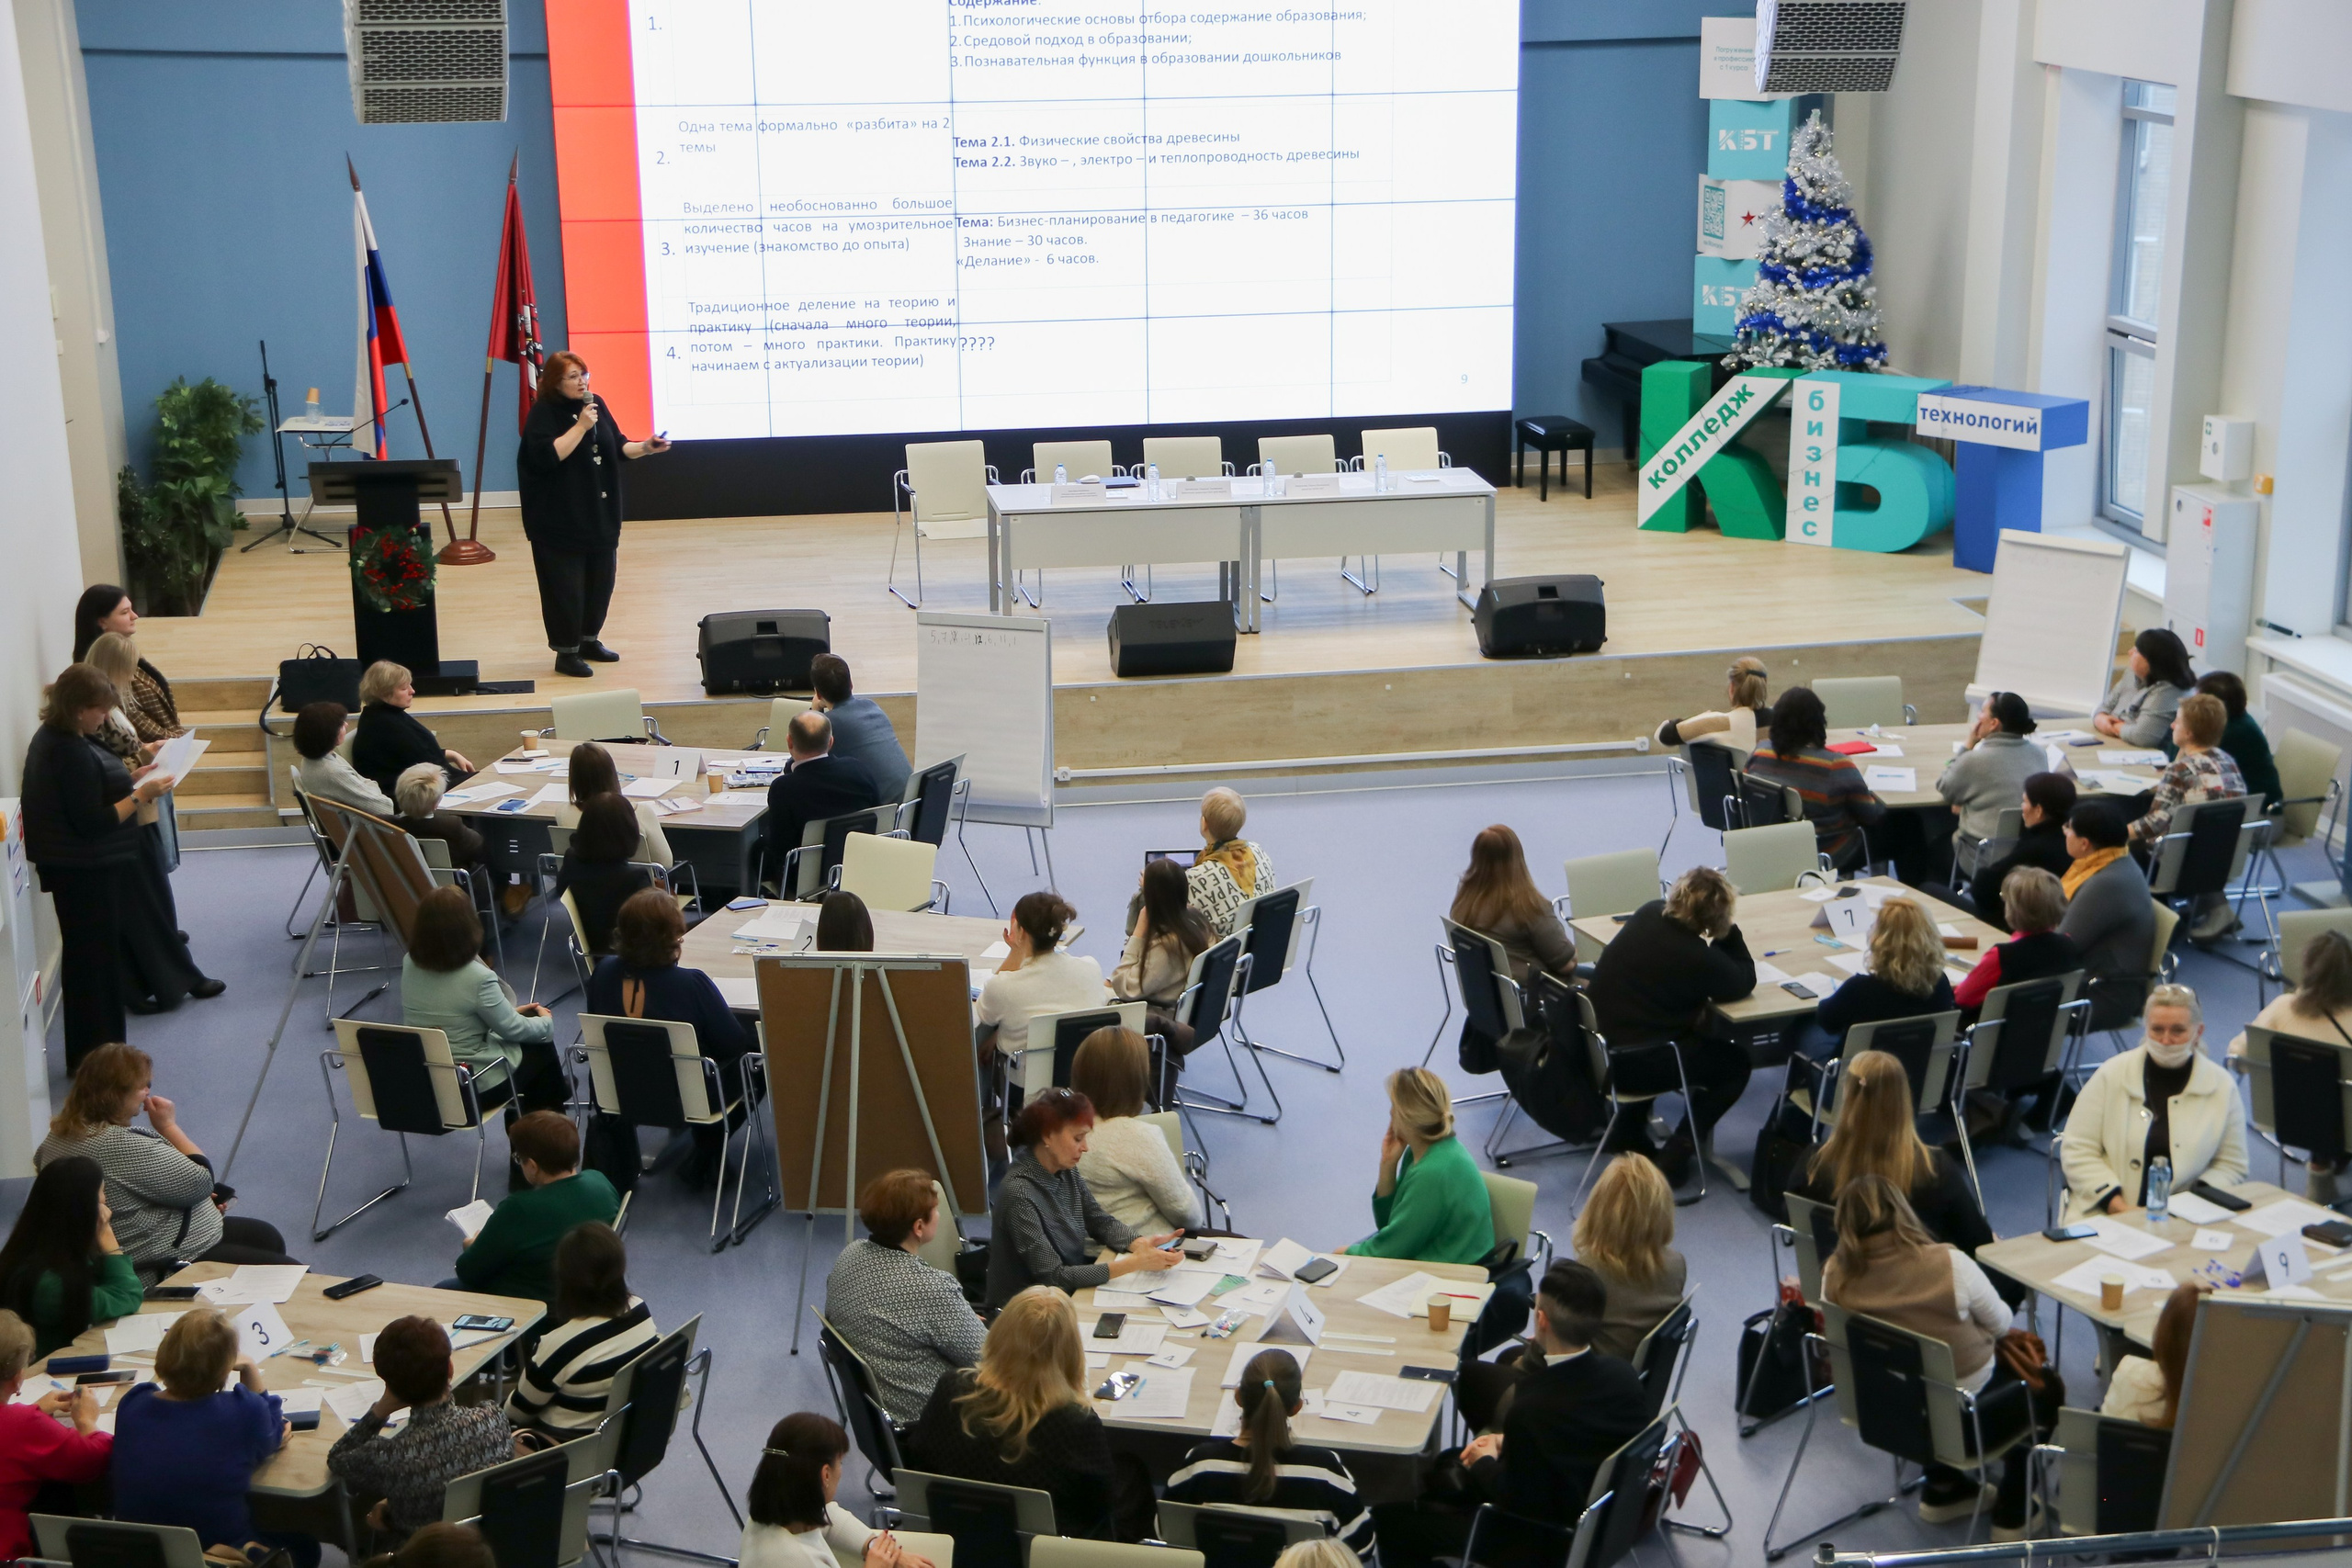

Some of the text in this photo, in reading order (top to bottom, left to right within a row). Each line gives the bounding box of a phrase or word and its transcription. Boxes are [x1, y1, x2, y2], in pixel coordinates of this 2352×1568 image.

[648, 17, 662, 31] 1.
[964, 15, 1080, 26] Психологические
[1085, 15, 1135, 25] основы
[1139, 12, 1186, 26] отбора
[1191, 12, 1272, 25] содержание
[1276, 9, 1367, 23] образования;
[964, 34, 1030, 49] Средовой
[1035, 35, 1083, 47] подход
[1088, 36, 1094, 44] в
[1099, 32, 1192, 46] образовании;
[965, 55, 1074, 67] Познавательная
[1079, 53, 1136, 67] функция
[1140, 55, 1148, 64] в
[1151, 51, 1239, 66] образовании
[1243, 51, 1341, 64] дошкольников
[678, 118, 950, 134] Одна тема формально «разбита» на 2
[680, 142, 716, 153] темы
[954, 132, 1239, 148] Тема 2.1. Физические свойства древесины
[1718, 130, 1779, 150] КБТ
[657, 151, 671, 165] 2.
[954, 157, 987, 167] Тема
[991, 156, 1015, 167] 2.2.
[1020, 156, 1057, 168] Звуко
[1080, 154, 1132, 166] электро
[1148, 155, 1156, 164] и
[1160, 152, 1283, 164] теплопроводность
[1286, 150, 1360, 163] древесины
[684, 197, 953, 215] Выделено необоснованно большое
[684, 220, 953, 234] количество часов на умозрительное
[956, 217, 993, 228] Тема:
[998, 214, 1145, 228] Бизнес-планирование
[1150, 214, 1157, 223] в
[1161, 211, 1235, 224] педагогике
[1253, 209, 1269, 220] 36
[1272, 209, 1308, 220] часов
[661, 243, 675, 255] 3.
[685, 237, 910, 255] изучение (знакомство до опыта)
[964, 236, 1012, 248] Знание
[1027, 235, 1043, 245] 30
[1046, 235, 1088, 245] часов.
[956, 255, 1030, 269] «Делание»
[1046, 254, 1055, 265] 6
[1058, 254, 1099, 265] часов.
[688, 298, 956, 315] Традиционное деление на теорию и
[690, 317, 956, 335] практику (сначала много теории,
[666, 346, 681, 359] 4.
[691, 343, 732, 353] потом
[763, 341, 805, 351] много
[817, 339, 883, 351] практики.
[895, 335, 956, 349] Практику
[692, 354, 923, 371] начинаем с актуализации теории)
[1461, 374, 1468, 384] 9
[1919, 405, 2039, 435] технологий
[1647, 383, 1755, 490] колледж
[1802, 389, 1825, 537] бизнес
[674, 760, 680, 775] 1
[1844, 908, 1854, 927] 7
[801, 935, 812, 951] 2
[2278, 1252, 2289, 1277] 9
[1298, 1304, 1315, 1325] 4
[252, 1321, 270, 1346] 3
